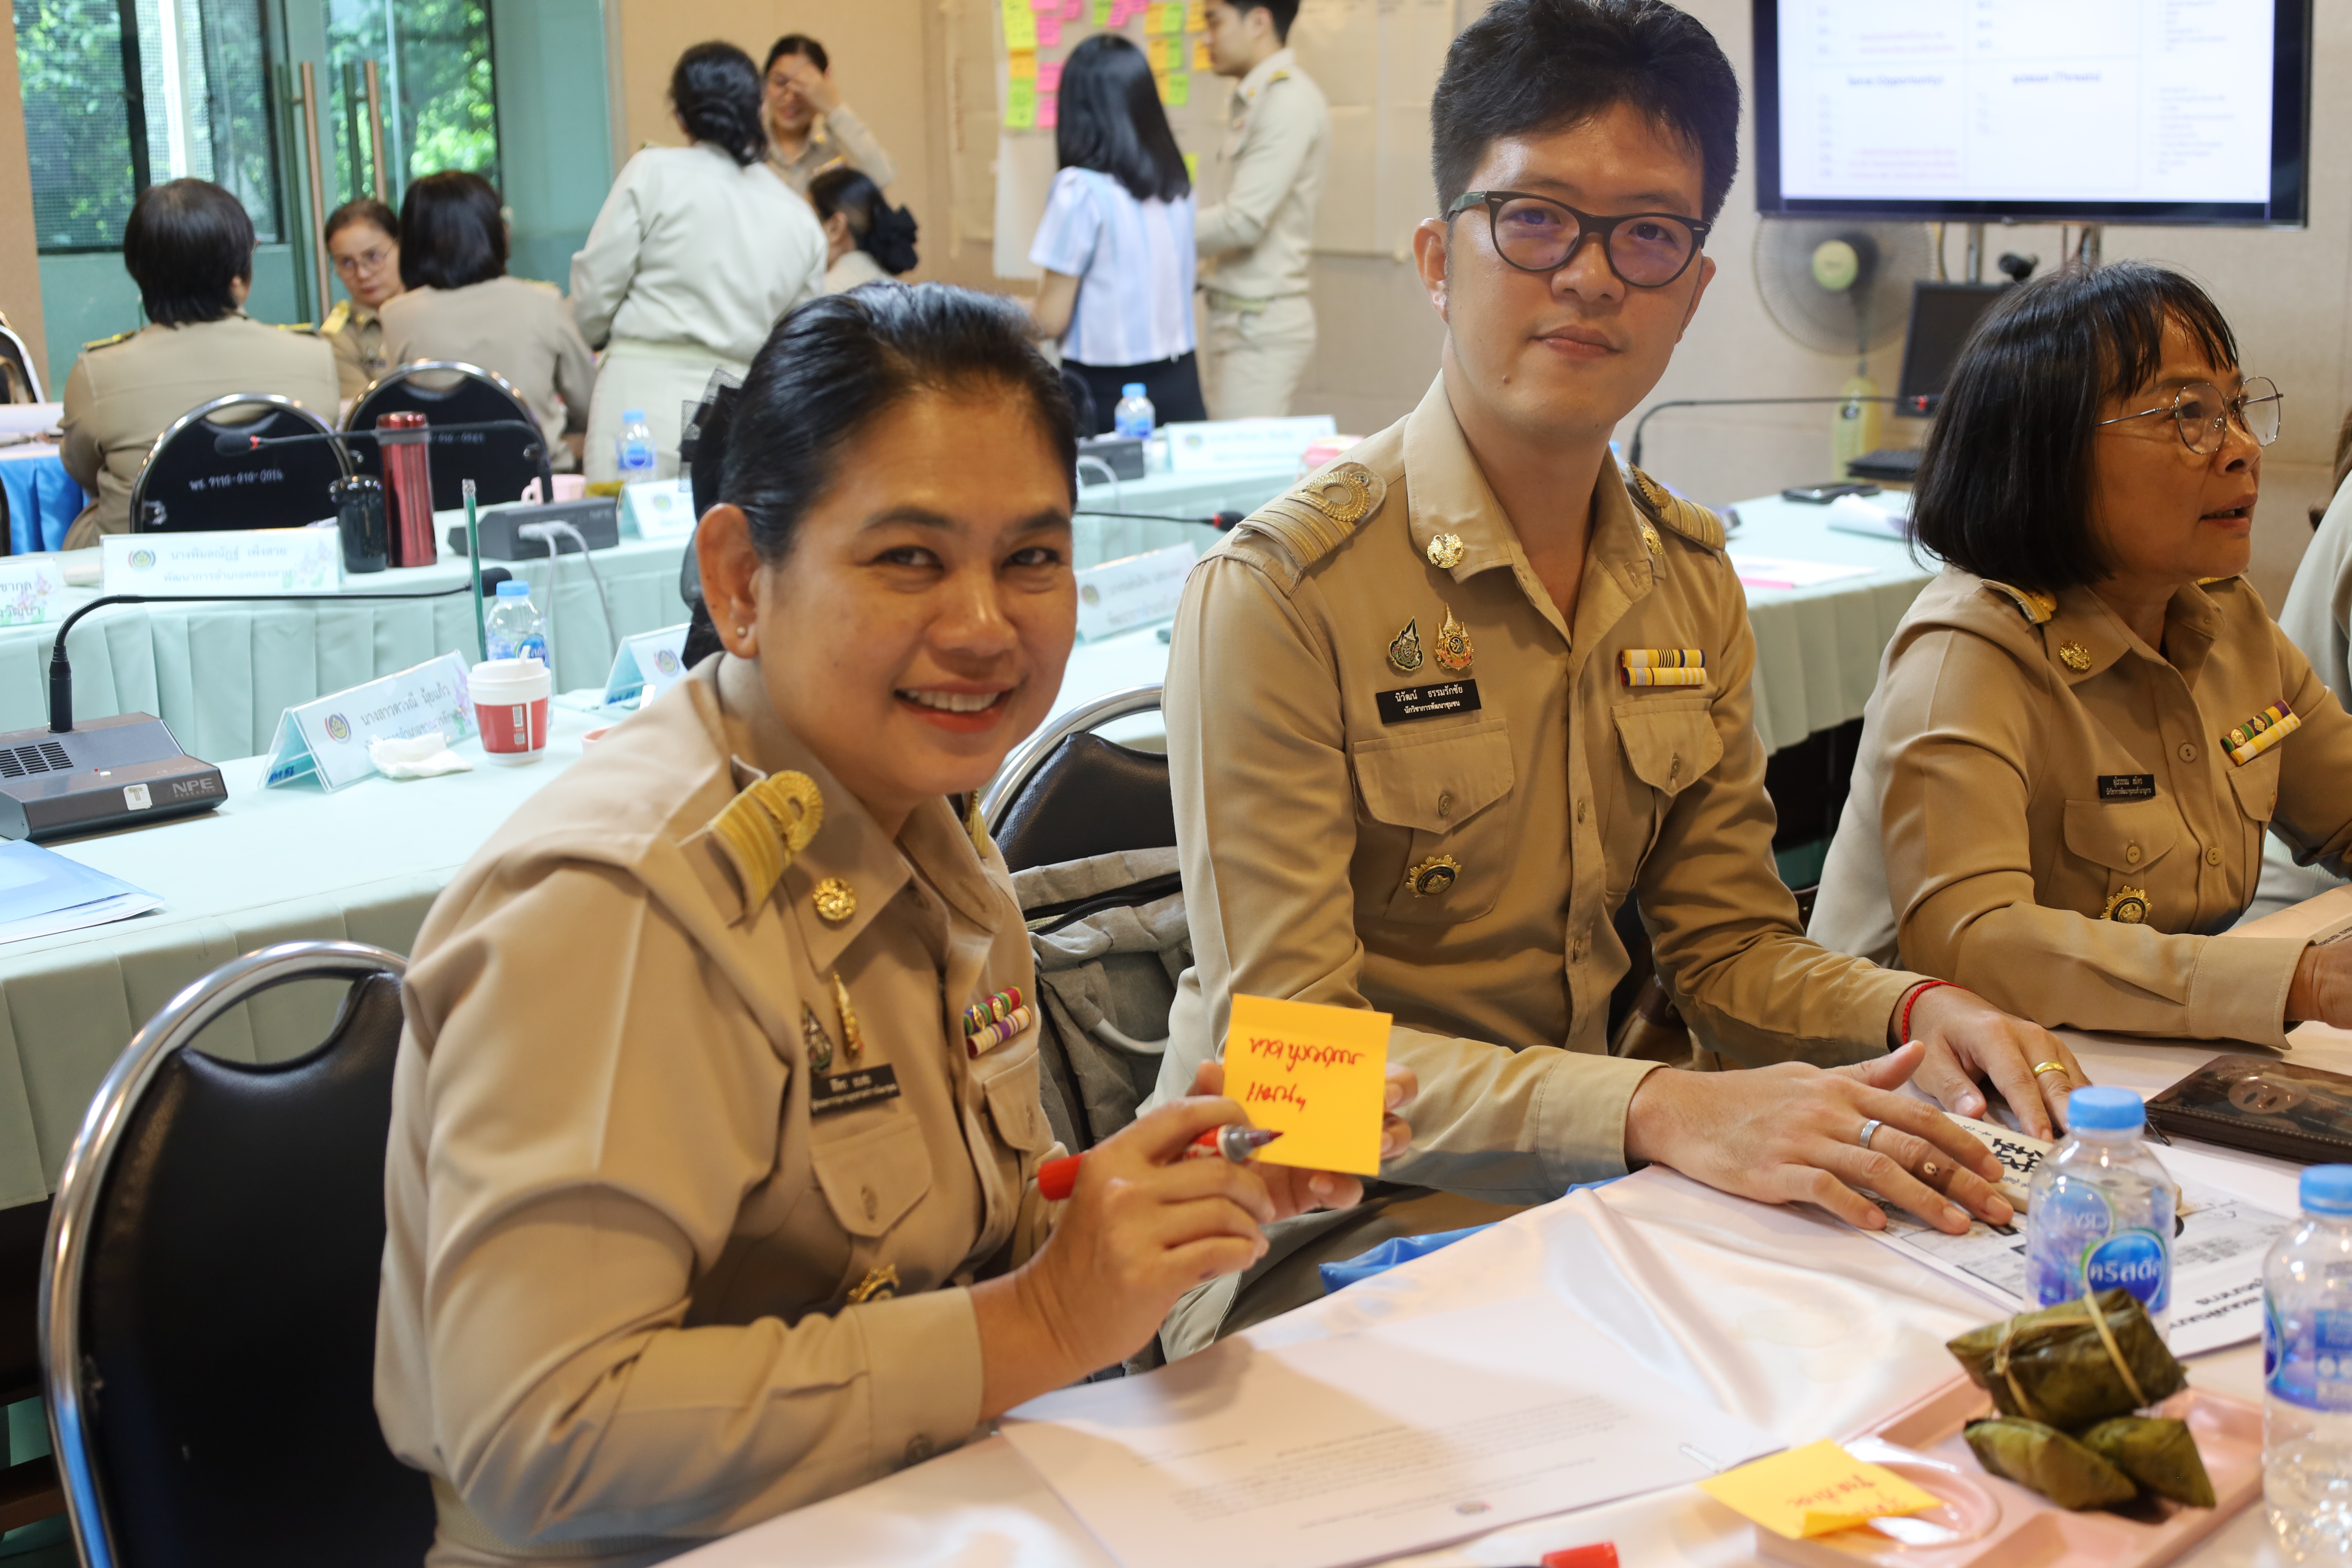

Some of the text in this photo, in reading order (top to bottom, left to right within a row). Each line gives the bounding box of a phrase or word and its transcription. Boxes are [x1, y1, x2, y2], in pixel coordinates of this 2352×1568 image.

[1395, 684, 1463, 702] นิวัฒน์ ธรรมรักชัย
[360, 691, 418, 726] นางสาวดารณี
[1404, 700, 1460, 714] นักวิชาการพัฒนาชุมชน
[172, 778, 214, 793] NPE
[175, 788, 216, 798] RESEARCH
